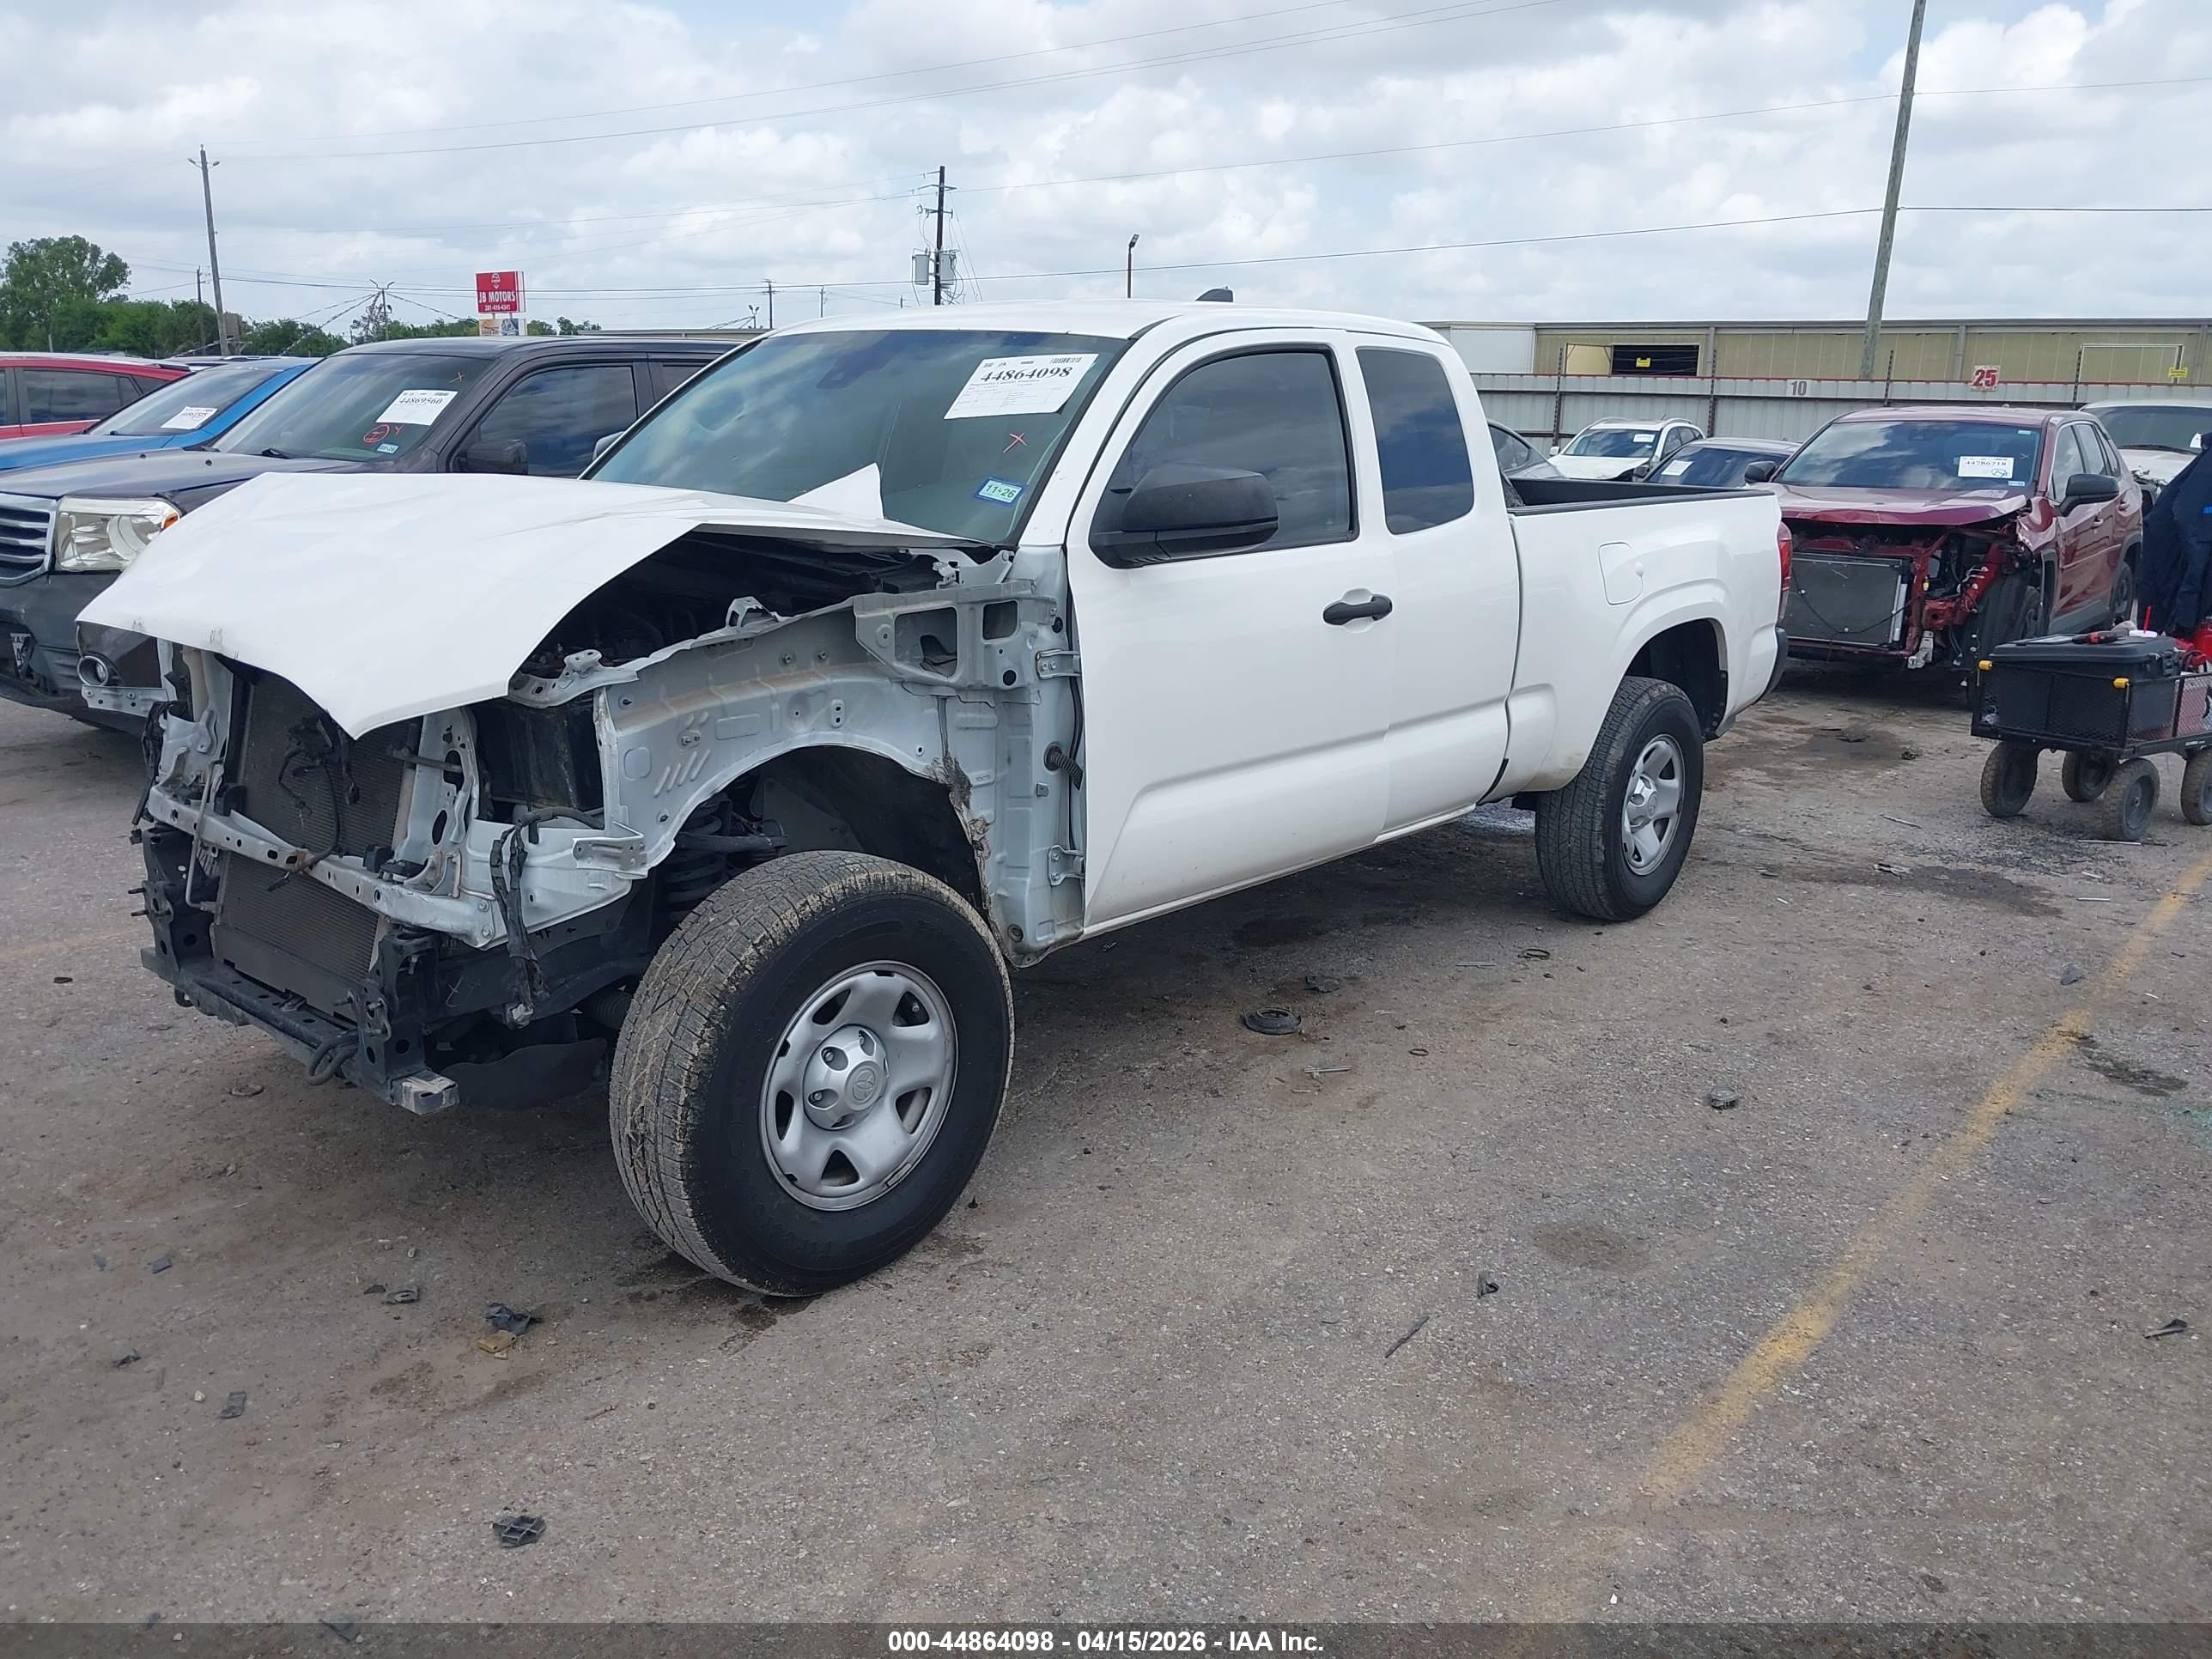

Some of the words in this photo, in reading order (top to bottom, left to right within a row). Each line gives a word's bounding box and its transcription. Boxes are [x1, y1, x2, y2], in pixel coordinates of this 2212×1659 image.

[479, 291, 487, 303] JB
[489, 290, 515, 303] MOTORS
[981, 367, 1073, 382] 44864098
[1972, 369, 1996, 386] 25
[1790, 380, 1808, 396] 10
